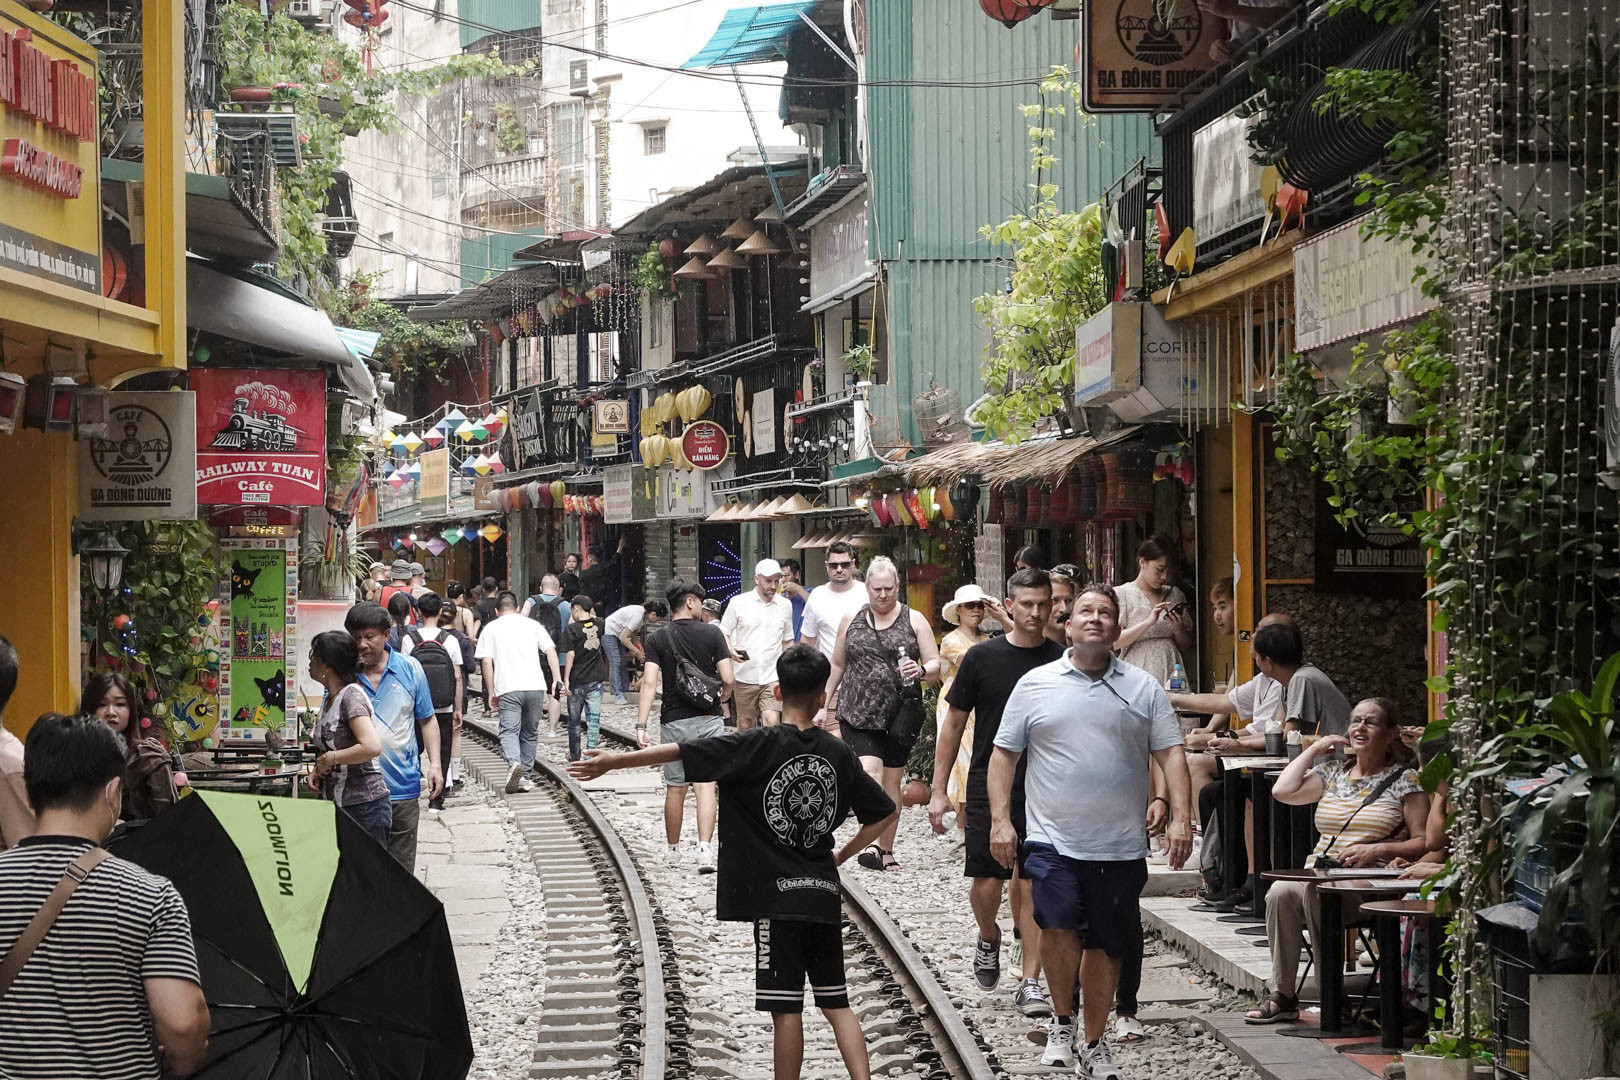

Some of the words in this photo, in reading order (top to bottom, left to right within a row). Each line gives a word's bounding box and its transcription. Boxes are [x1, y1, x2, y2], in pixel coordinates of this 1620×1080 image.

[1098, 70, 1117, 88] GA
[1121, 67, 1162, 88] ĐÔNG
[197, 461, 267, 481] RAILWAY
[272, 462, 314, 480] TUAN
[91, 488, 104, 501] GA
[138, 486, 172, 501] DƯƠNG
[238, 480, 274, 491] Café
[1336, 549, 1353, 565] GA
[758, 918, 770, 970] RDAN
